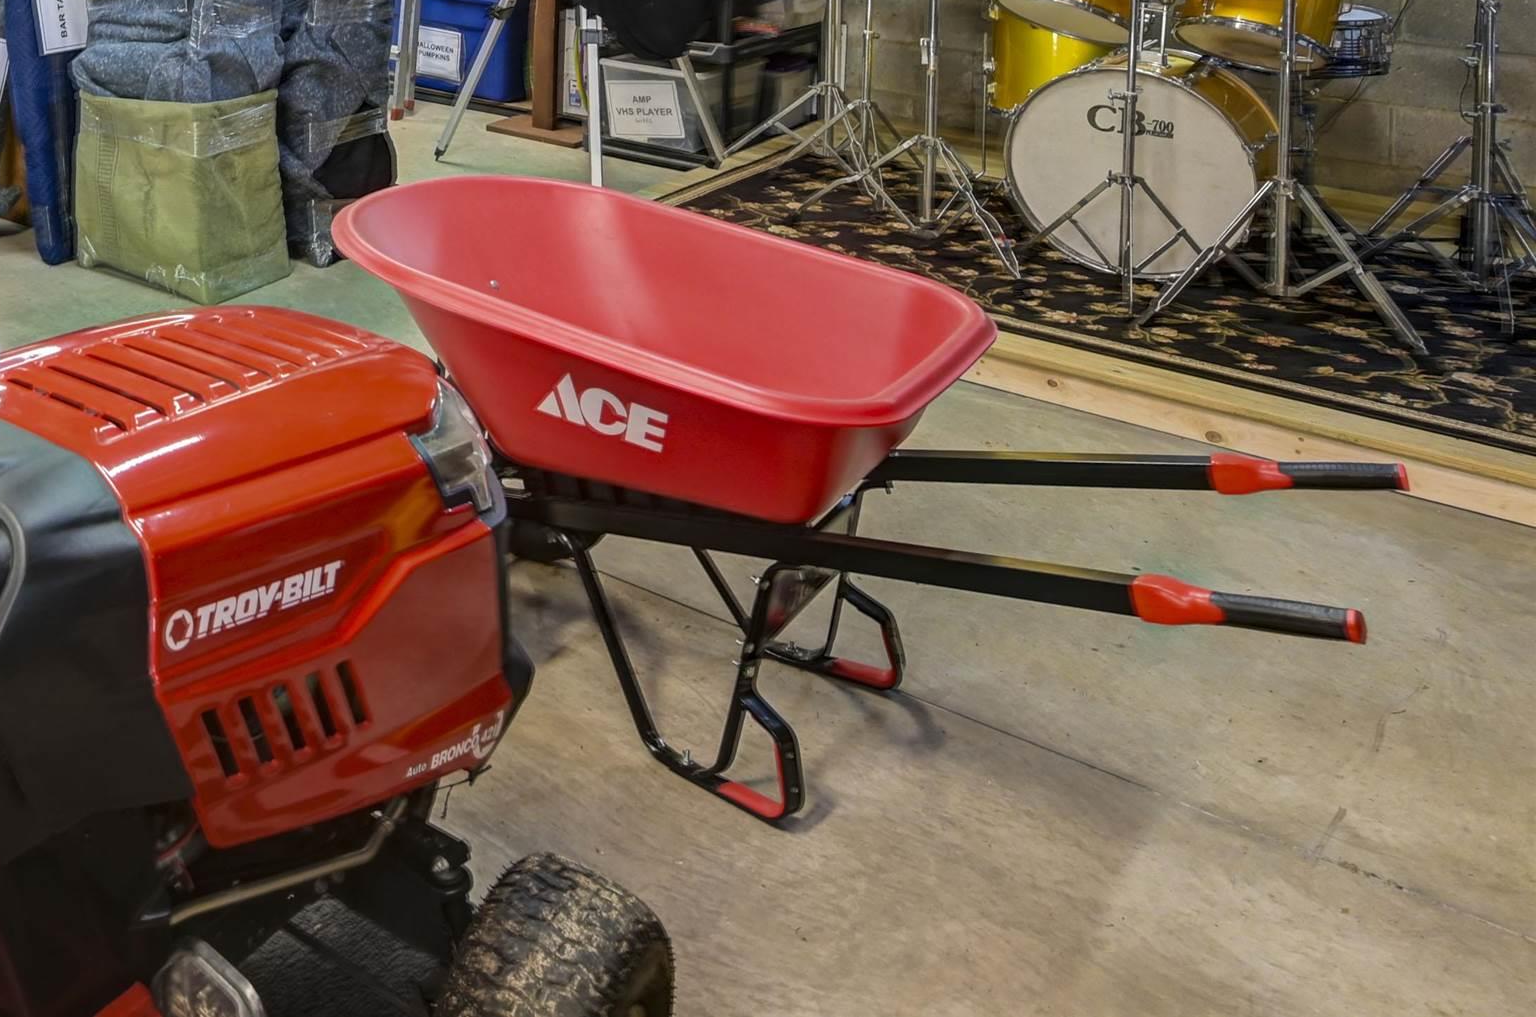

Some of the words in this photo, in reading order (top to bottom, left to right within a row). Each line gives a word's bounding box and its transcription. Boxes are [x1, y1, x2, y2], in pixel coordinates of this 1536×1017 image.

[58, 14, 68, 39] BAR
[418, 50, 451, 62] PUMPKINS
[615, 107, 634, 116] VHS
[636, 107, 673, 116] PLAYER
[632, 95, 652, 104] AMP
[536, 372, 668, 454] ACE
[195, 559, 345, 639] TROY-BILT
[406, 762, 427, 778] Auto
[430, 734, 480, 771] BRONCO
